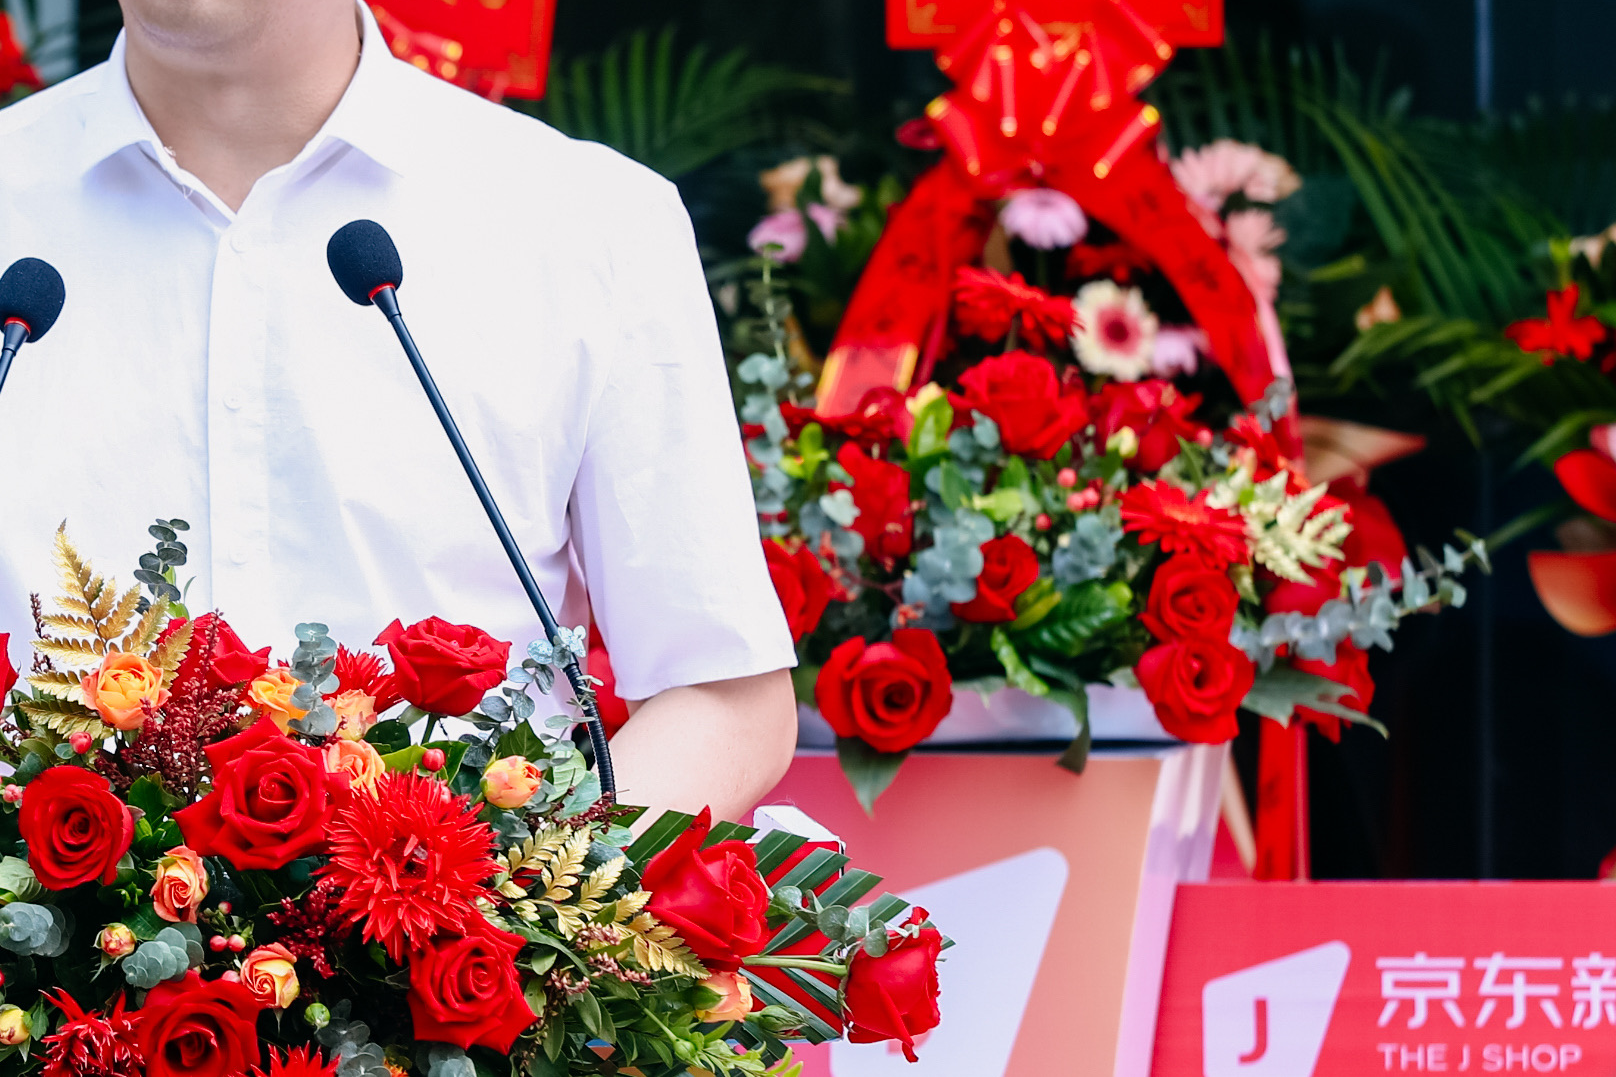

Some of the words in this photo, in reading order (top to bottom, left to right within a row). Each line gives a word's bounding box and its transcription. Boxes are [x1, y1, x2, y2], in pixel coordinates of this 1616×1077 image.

[1237, 997, 1269, 1067] J
[1376, 1042, 1448, 1072] THE
[1458, 1042, 1471, 1072] J
[1482, 1042, 1583, 1072] SHOP
